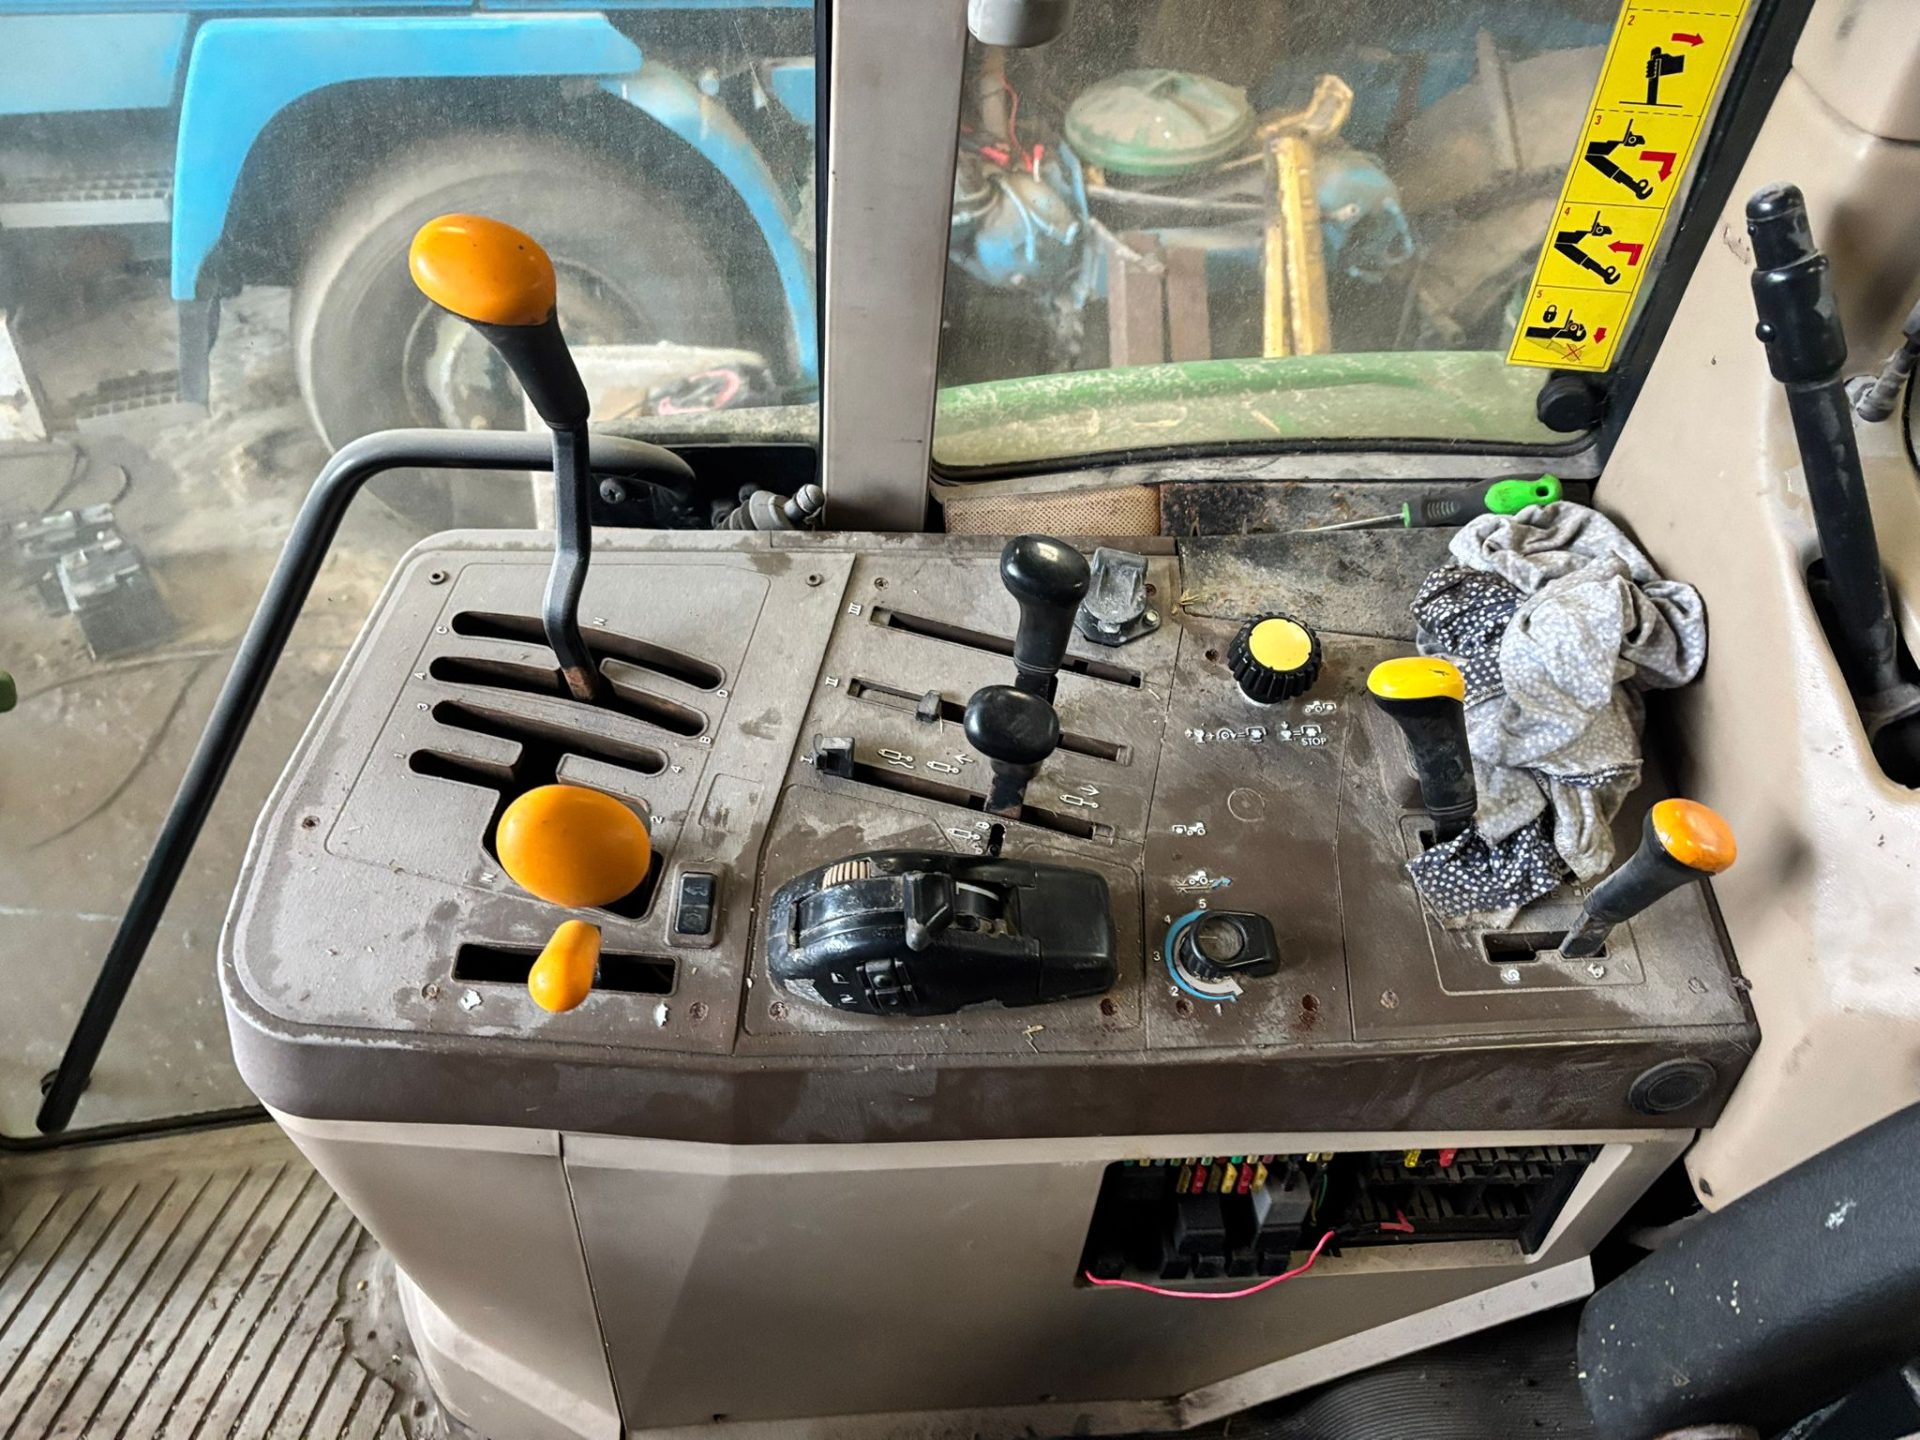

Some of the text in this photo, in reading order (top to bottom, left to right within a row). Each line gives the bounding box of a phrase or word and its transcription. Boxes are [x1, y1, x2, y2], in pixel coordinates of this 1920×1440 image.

[1627, 15, 1635, 26] 2
[1595, 115, 1602, 125] 3
[1564, 208, 1571, 217] 4
[1537, 290, 1543, 299] 5
[593, 617, 606, 627] N
[436, 624, 448, 635] C
[415, 671, 427, 680] A
[417, 702, 429, 711] 3
[699, 735, 712, 745] B
[1301, 737, 1327, 746] STOP
[671, 764, 684, 774] 4
[650, 815, 663, 825] 2
[481, 872, 496, 883] N
[1199, 899, 1207, 909] 5
[1163, 914, 1171, 924] 4
[1153, 951, 1161, 961] 3
[1170, 985, 1179, 997] 2
[1214, 1003, 1222, 1016] 1
